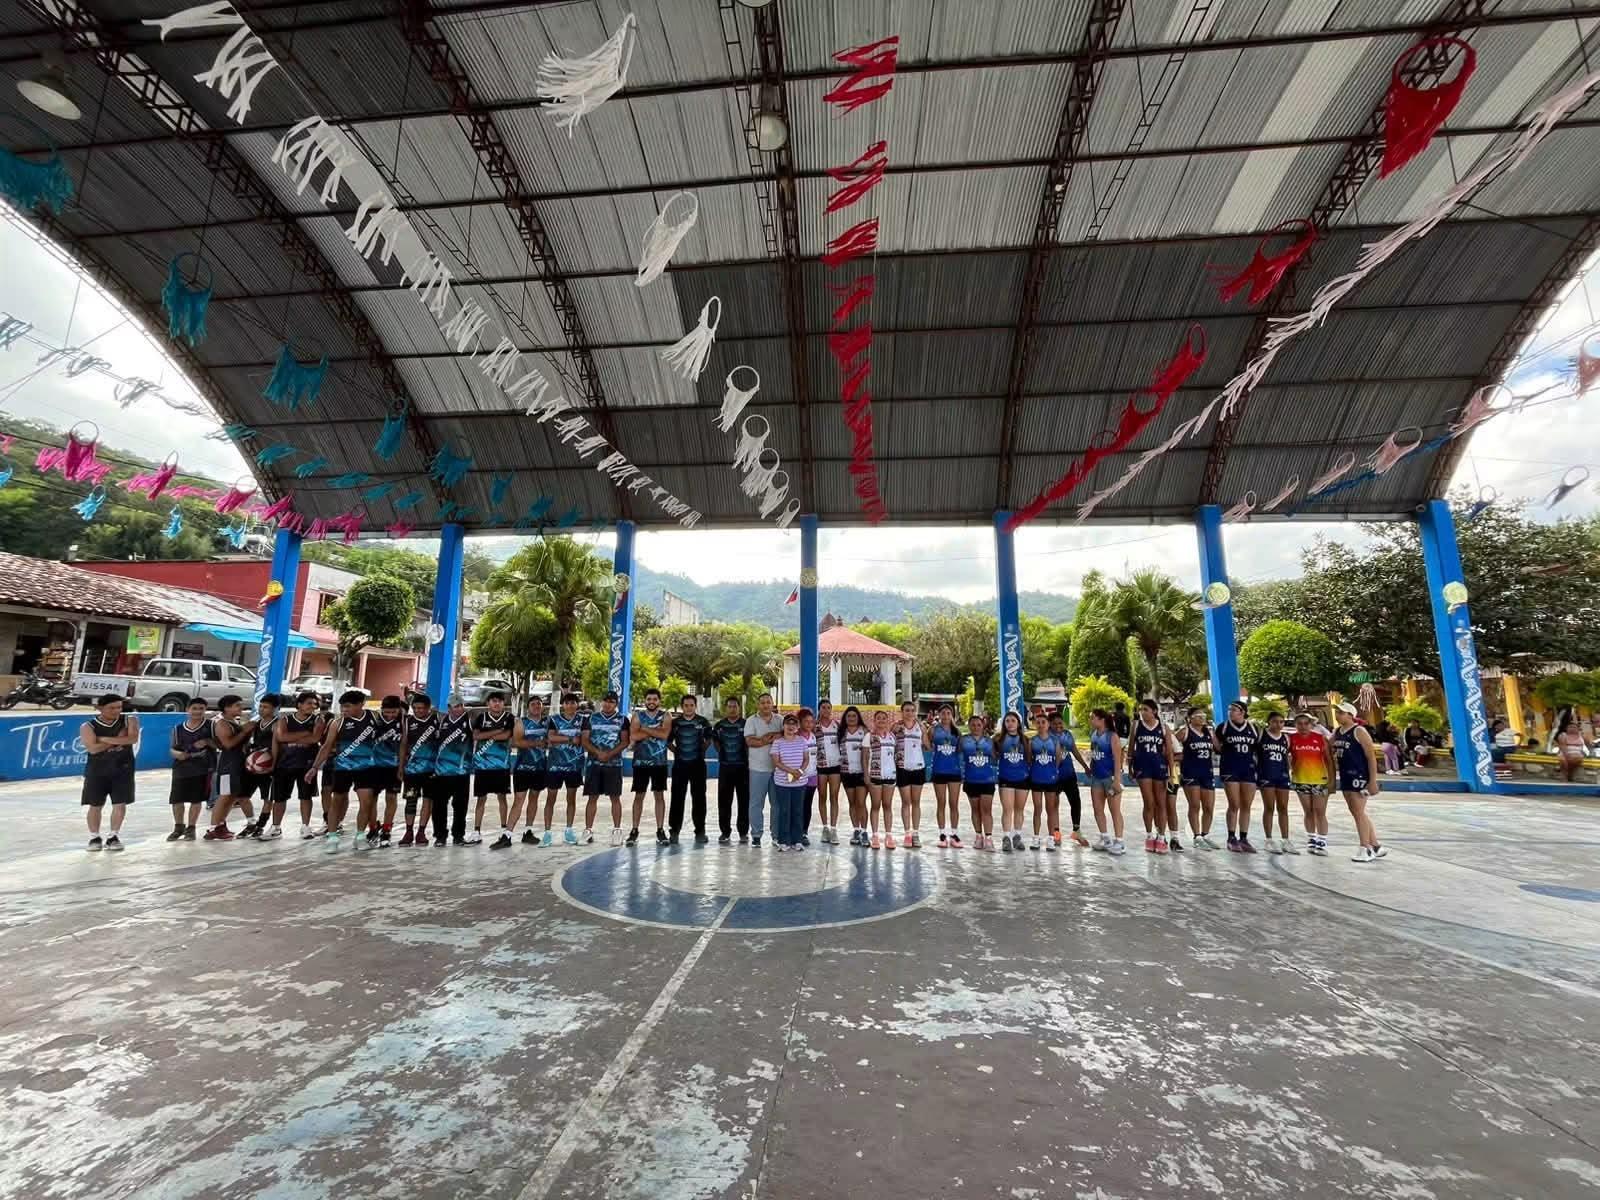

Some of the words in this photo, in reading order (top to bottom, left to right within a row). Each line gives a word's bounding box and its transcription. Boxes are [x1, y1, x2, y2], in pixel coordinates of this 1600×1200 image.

[1144, 743, 1157, 753] 14
[1235, 743, 1249, 753] 10
[1197, 750, 1210, 759] 23
[1269, 751, 1282, 762] 20
[1352, 779, 1367, 788] 07
